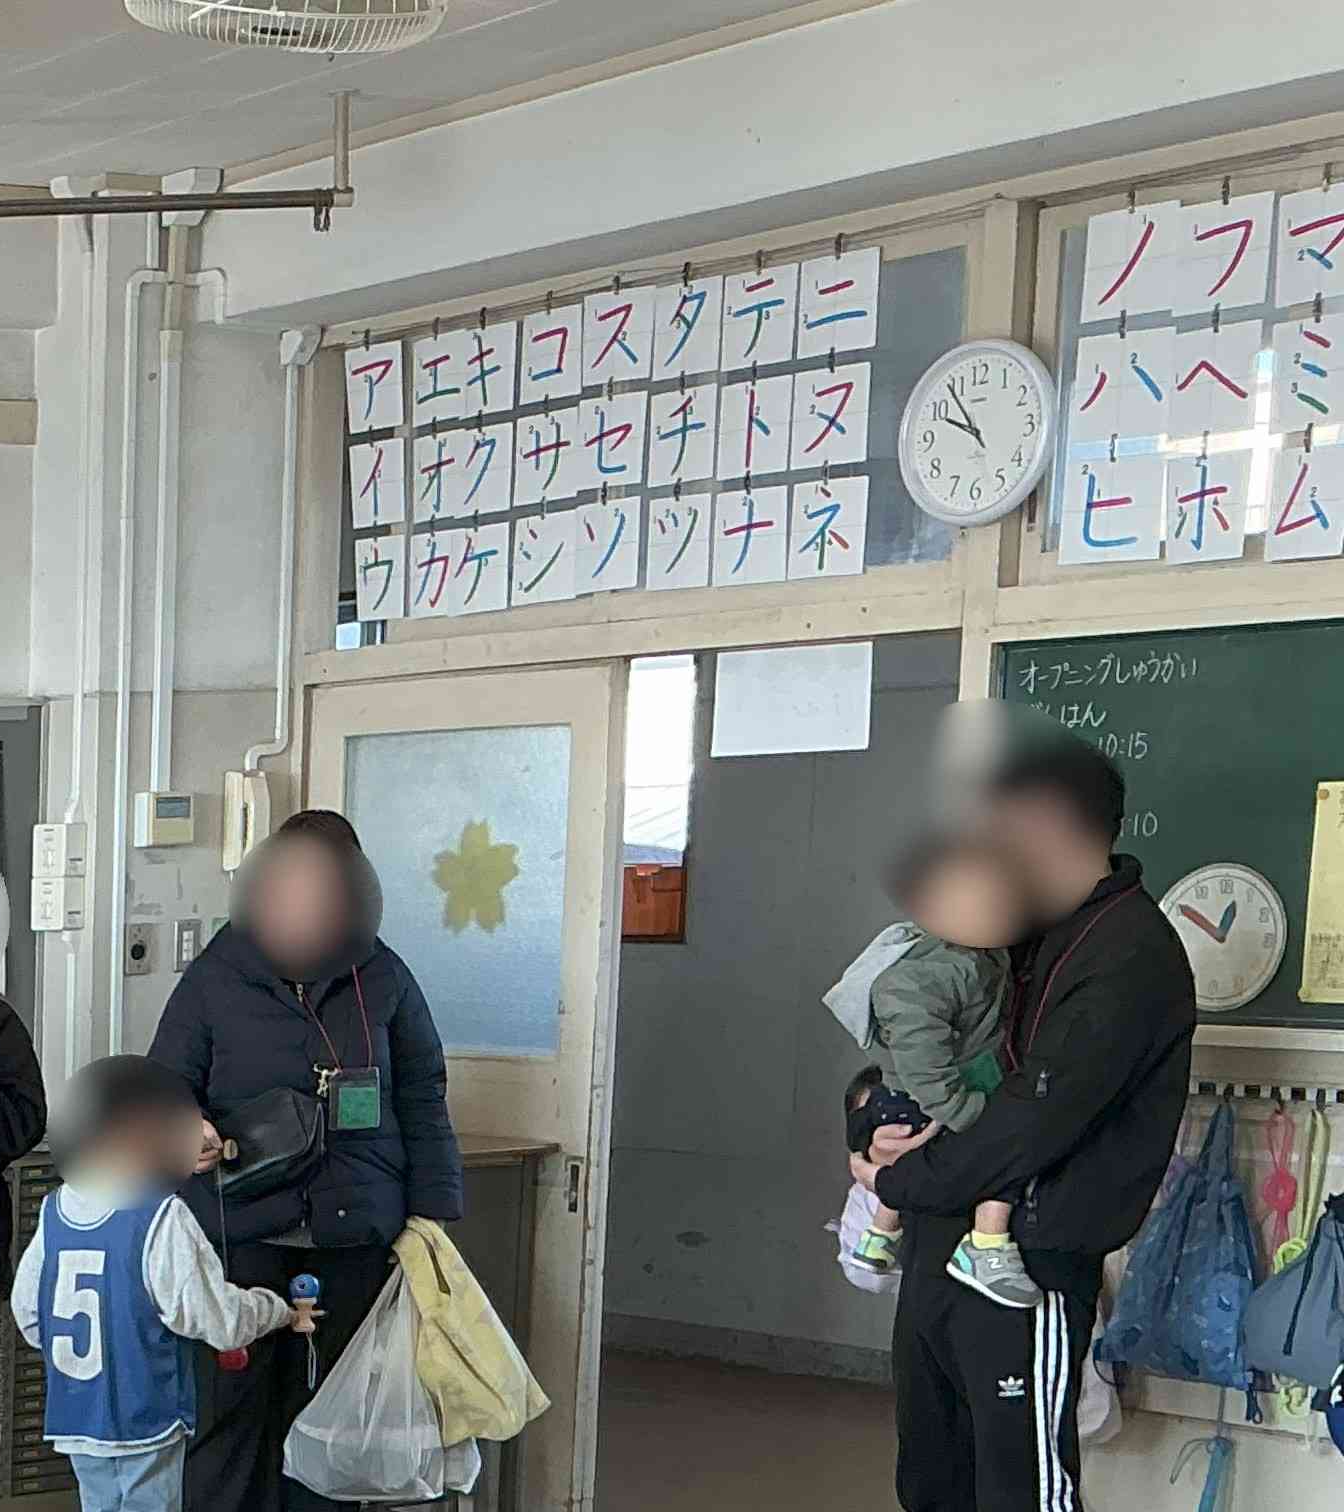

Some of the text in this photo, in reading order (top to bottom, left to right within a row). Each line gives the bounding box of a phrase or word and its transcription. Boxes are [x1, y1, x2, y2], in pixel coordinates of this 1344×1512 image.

[1097, 212, 1344, 306] ノ フ マ
[351, 277, 868, 421] ア エ キ コ ス タ テ ニ
[971, 362, 990, 386] 12
[1080, 329, 1332, 415] ハ ヘ ミ
[1016, 384, 1028, 407] 2
[931, 399, 949, 422] 10
[1022, 413, 1036, 438] 3
[360, 381, 854, 517] イ オ ク サ セ チ ト ヌ
[922, 430, 935, 453] 9
[929, 457, 942, 480] 8
[1010, 444, 1024, 468] 4
[949, 475, 961, 498] 7
[969, 478, 982, 501] 6
[993, 467, 1006, 493] 5
[1082, 463, 1330, 552] ヒ ホ ム
[362, 485, 850, 611] ウ カ ケ シ ソ ツ ナ ネ
[1018, 650, 1200, 695] オープニングしゅうかい
[50, 1249, 107, 1383] 5
